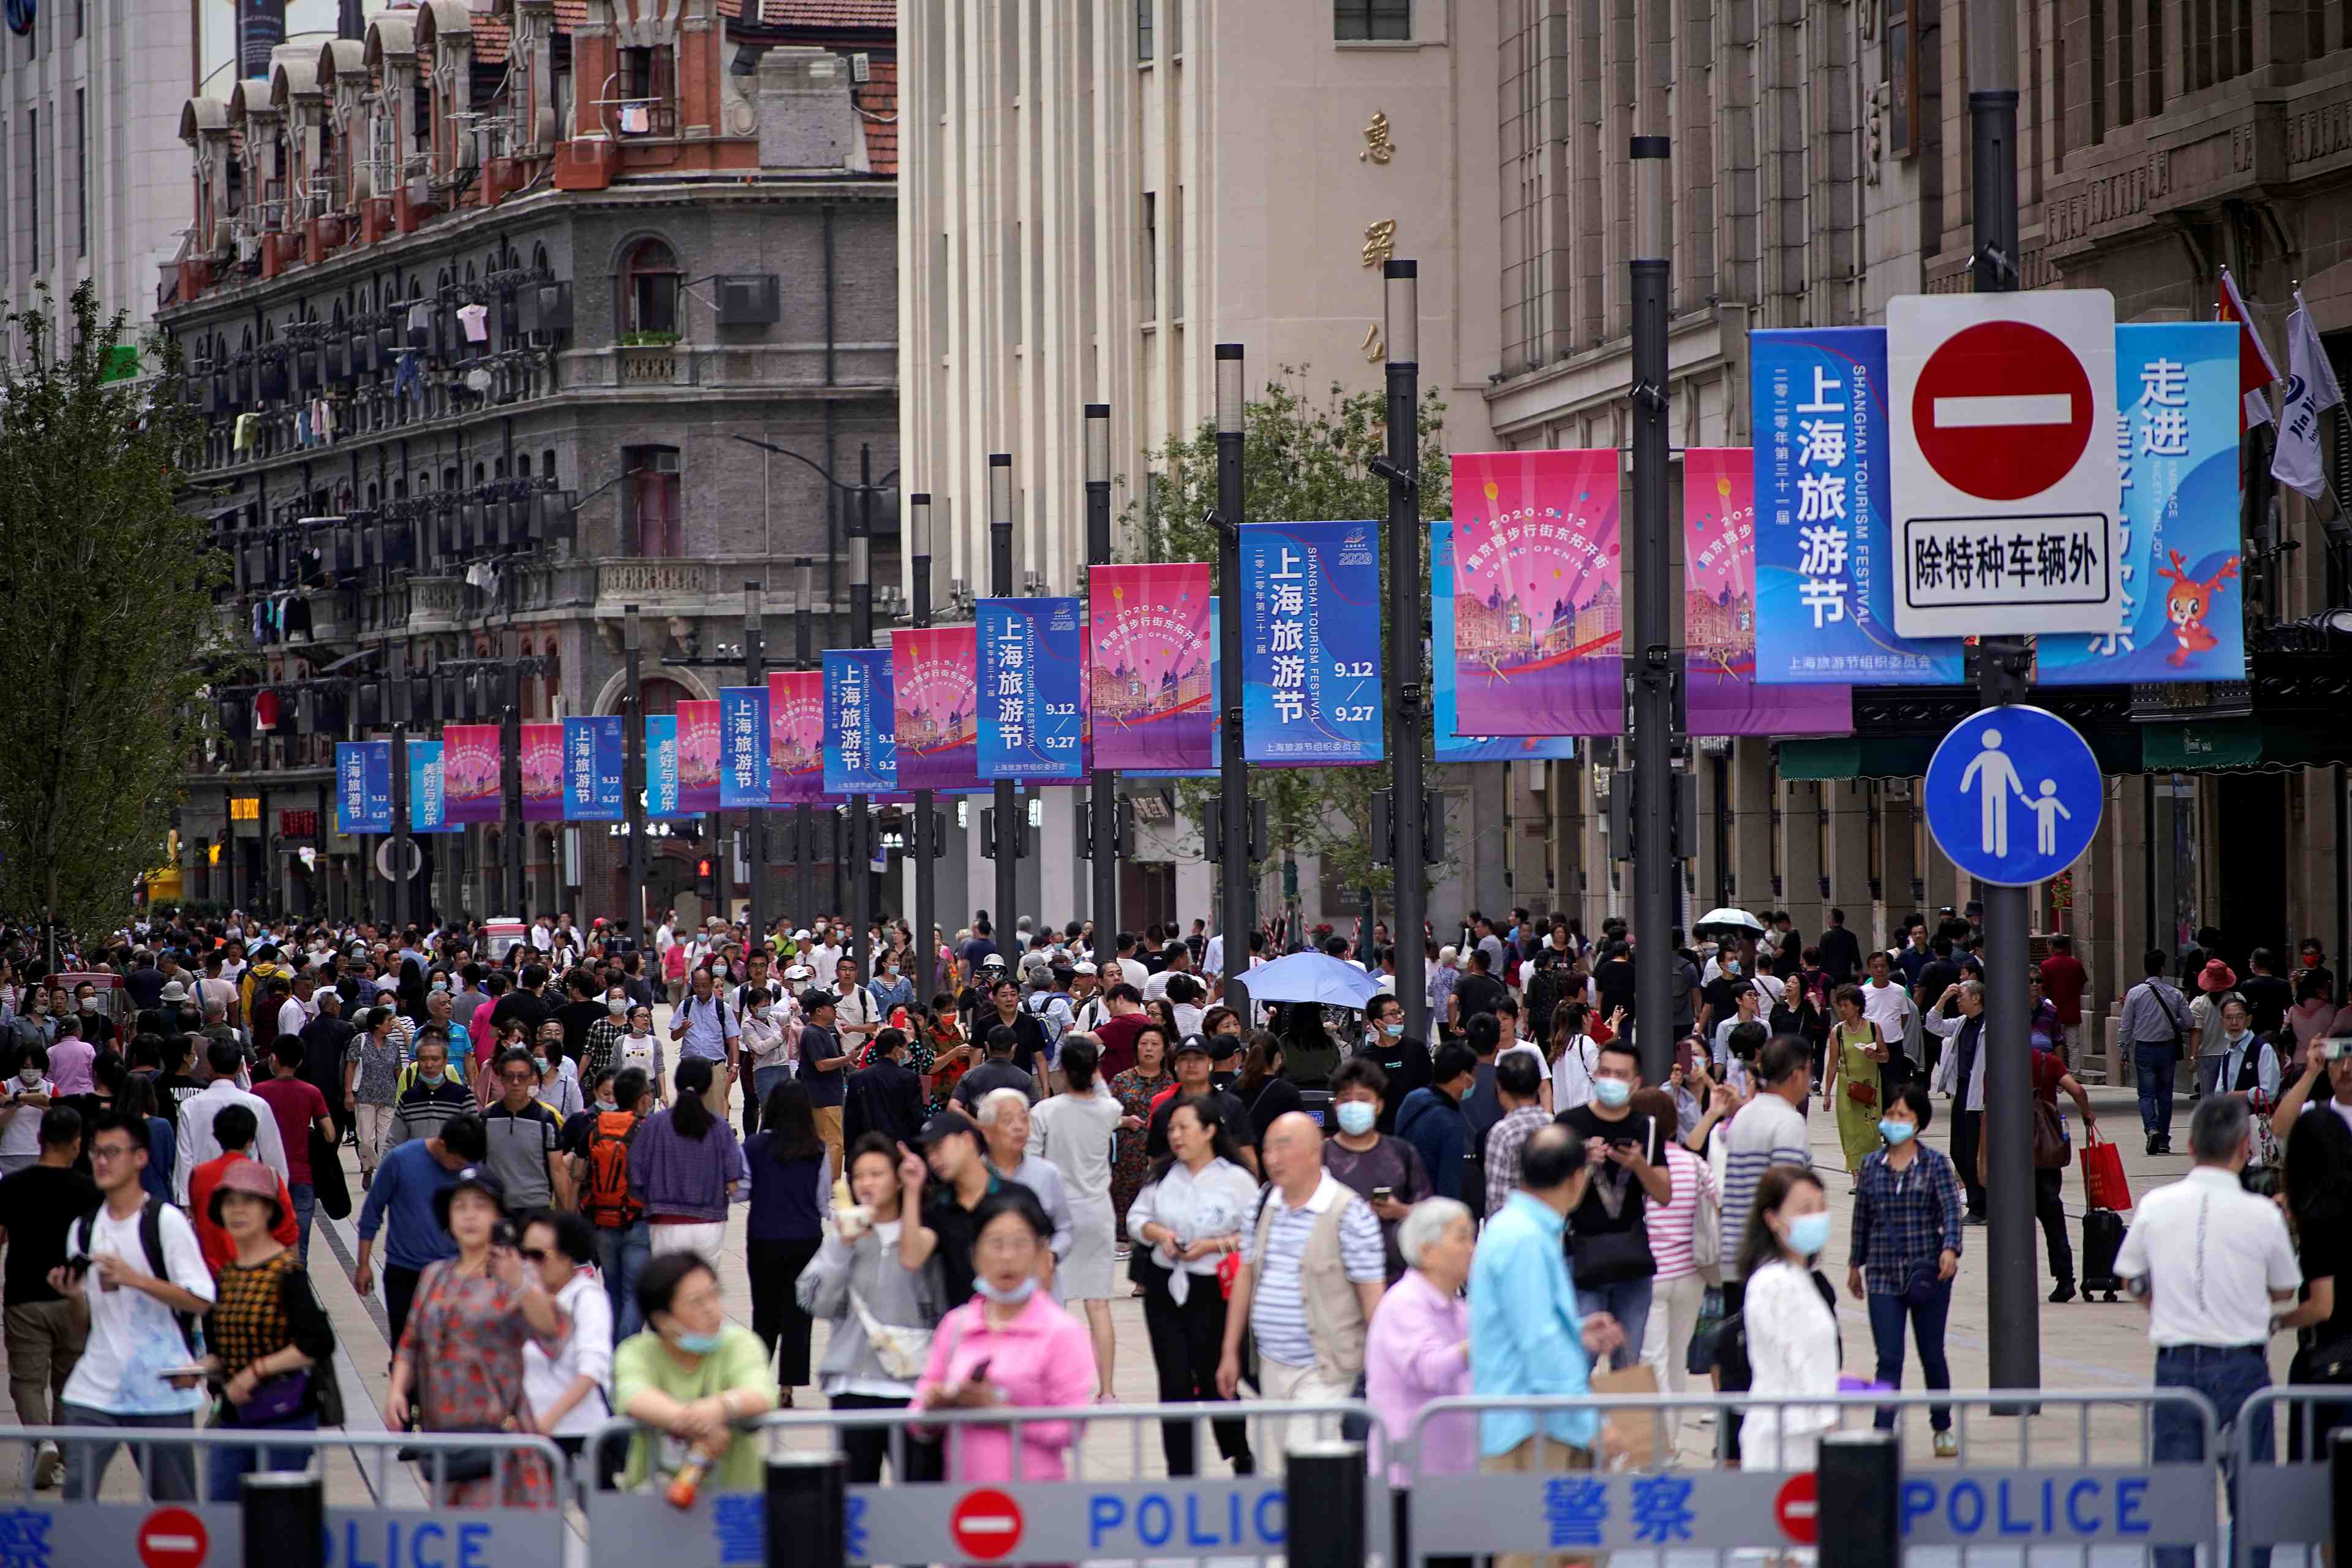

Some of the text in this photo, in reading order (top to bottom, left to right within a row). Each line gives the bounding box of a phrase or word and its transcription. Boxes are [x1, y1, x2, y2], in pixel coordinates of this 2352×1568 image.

[2139, 357, 2188, 457] 走进
[2289, 413, 2310, 445] Jin
[1774, 368, 1790, 525] 二零二零年第三十一届
[1488, 507, 1587, 530] 2020.9.12
[1796, 365, 1849, 629] 上海旅游节
[1853, 365, 1869, 627] SHANGHAI TOURISM FESTIVAL
[1467, 524, 1610, 570] 南京路步行街东拓开街
[1486, 547, 1527, 578] GRAND
[1534, 545, 1589, 578] OPENING
[1915, 532, 2097, 589] 除特种车辆外
[1116, 605, 1186, 621] 2020.9.12
[1255, 549, 1266, 654] 二零二零年第三十一届
[1270, 548, 1305, 723] 上海旅游节
[1308, 548, 1320, 723] SHANGHAI TOURISM FESTIVAL
[998, 617, 1024, 749] 上海旅游节
[1334, 662, 1374, 677] 9.12
[840, 665, 862, 771] 上海旅游节
[1046, 703, 1076, 715] 9.12
[1046, 736, 1076, 748] 9.27
[1335, 706, 1374, 722] 9.27
[575, 726, 590, 804] 上海旅游节
[660, 739, 675, 811] 美好与欢乐
[734, 699, 752, 789] 上海旅游节
[1265, 741, 1362, 753] 上海旅游节组织委员会
[347, 751, 361, 819] 上海旅游节
[1543, 1472, 1695, 1546] 警察
[1901, 1477, 2152, 1536] POLICE
[323, 1519, 492, 1568] LICE
